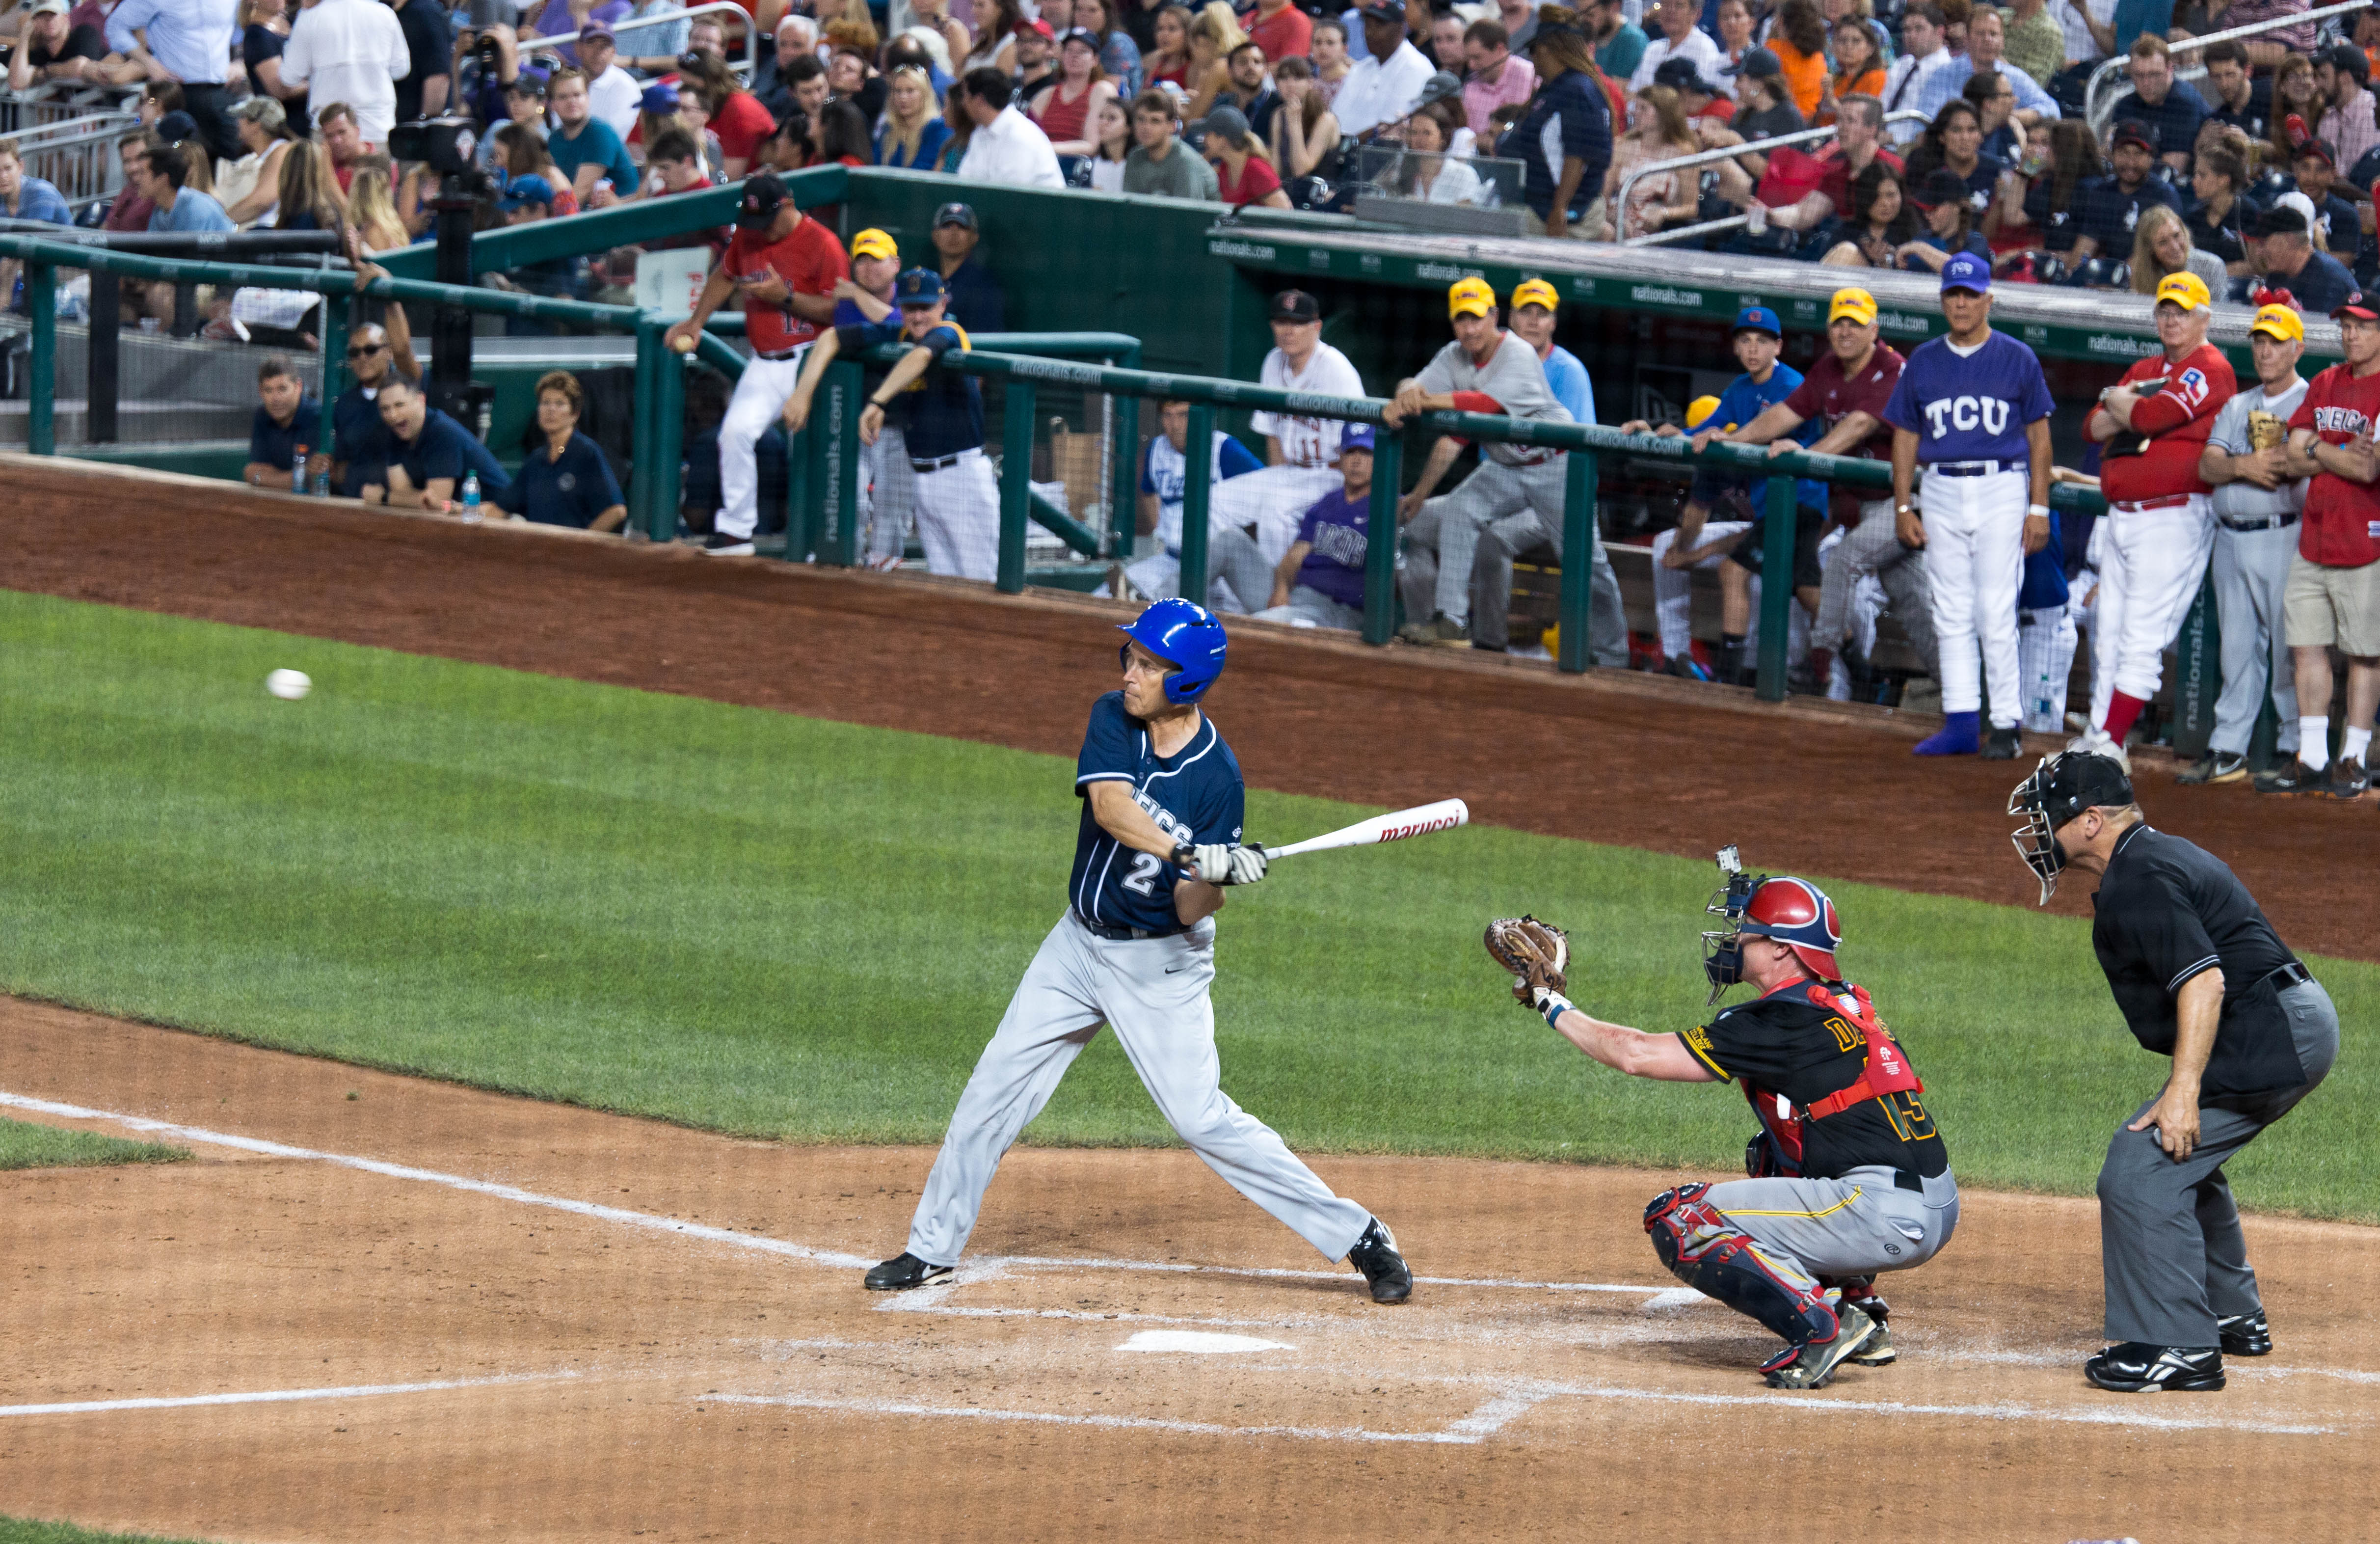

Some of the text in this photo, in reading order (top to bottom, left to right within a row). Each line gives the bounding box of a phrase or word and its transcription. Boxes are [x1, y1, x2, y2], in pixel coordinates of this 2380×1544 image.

[1209, 240, 1275, 259] nationals.com
[1952, 262, 1973, 275] TCU
[1631, 285, 1702, 307] nationals.com
[2025, 325, 2047, 338] MGM
[1009, 359, 1101, 386] nationals.com
[1285, 391, 1382, 415] nationals.com
[1925, 395, 2010, 440] TCU
[1585, 427, 1684, 456] nationals.com
[826, 384, 842, 542] nationals.com
[1376, 809, 1460, 843] marucci
[1121, 850, 1162, 897] 2
